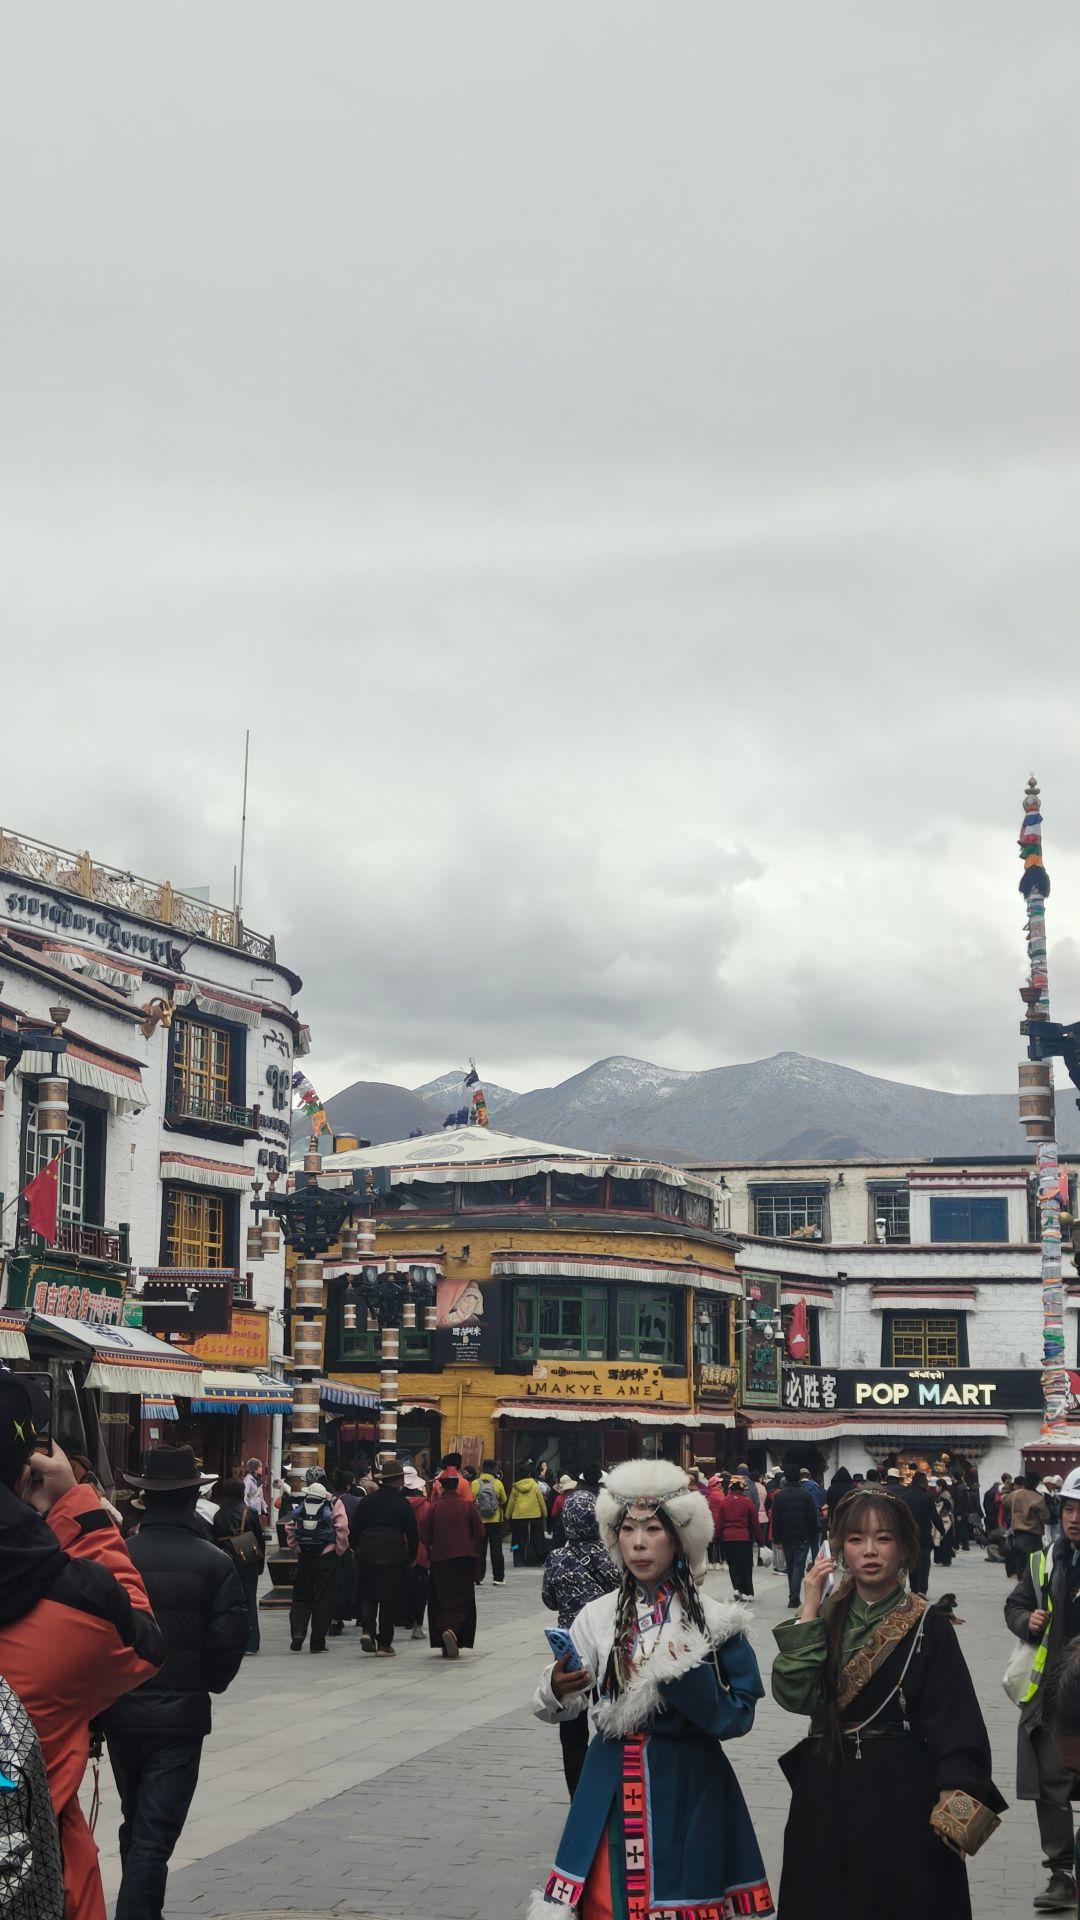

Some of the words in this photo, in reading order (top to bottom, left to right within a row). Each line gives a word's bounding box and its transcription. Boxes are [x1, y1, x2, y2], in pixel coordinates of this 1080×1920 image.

[536, 1382, 603, 1395] MAKYE
[616, 1386, 652, 1396] AME
[785, 1373, 837, 1408] 必胜客
[856, 1383, 909, 1405] POP
[919, 1383, 996, 1405] MART
